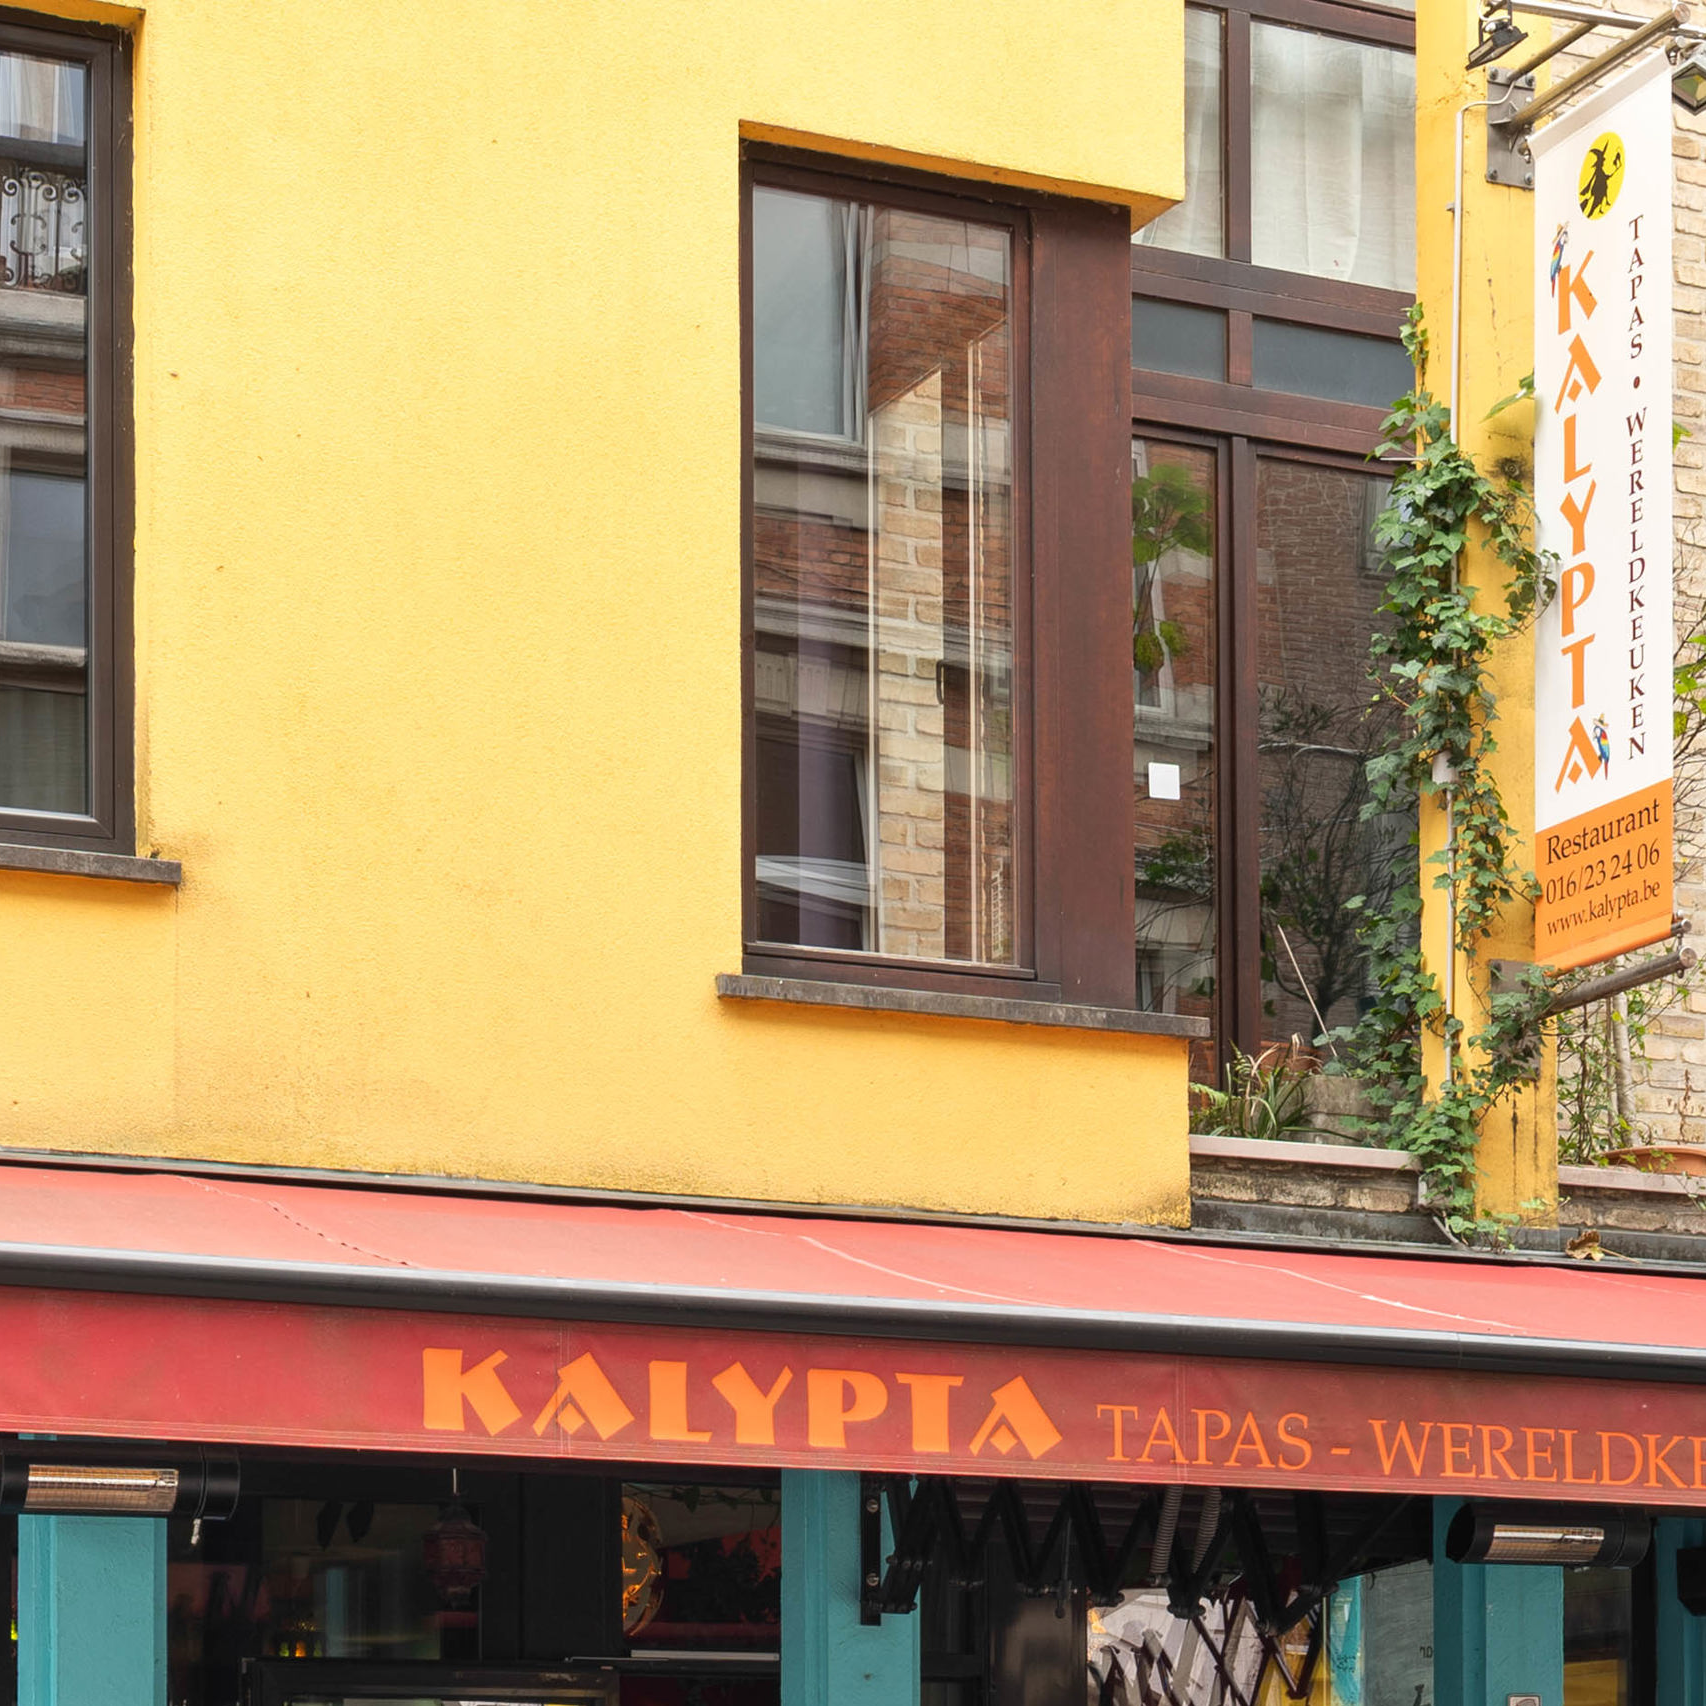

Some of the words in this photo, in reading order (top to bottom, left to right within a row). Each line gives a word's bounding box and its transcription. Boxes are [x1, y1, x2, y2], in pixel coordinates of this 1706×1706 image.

[1629, 214, 1644, 361] TAPAS
[1555, 250, 1602, 794] KALYPTA
[1625, 406, 1647, 761] WERELDKEUKEN
[1545, 798, 1660, 865] Restaurant
[1546, 859, 1607, 905] 016/23
[1610, 849, 1633, 881] 24
[1637, 842, 1660, 870] 06
[1547, 879, 1661, 936] www.kalypta.be
[423, 1347, 1065, 1460] KALYPTA
[1095, 1403, 1313, 1472] TAPAS
